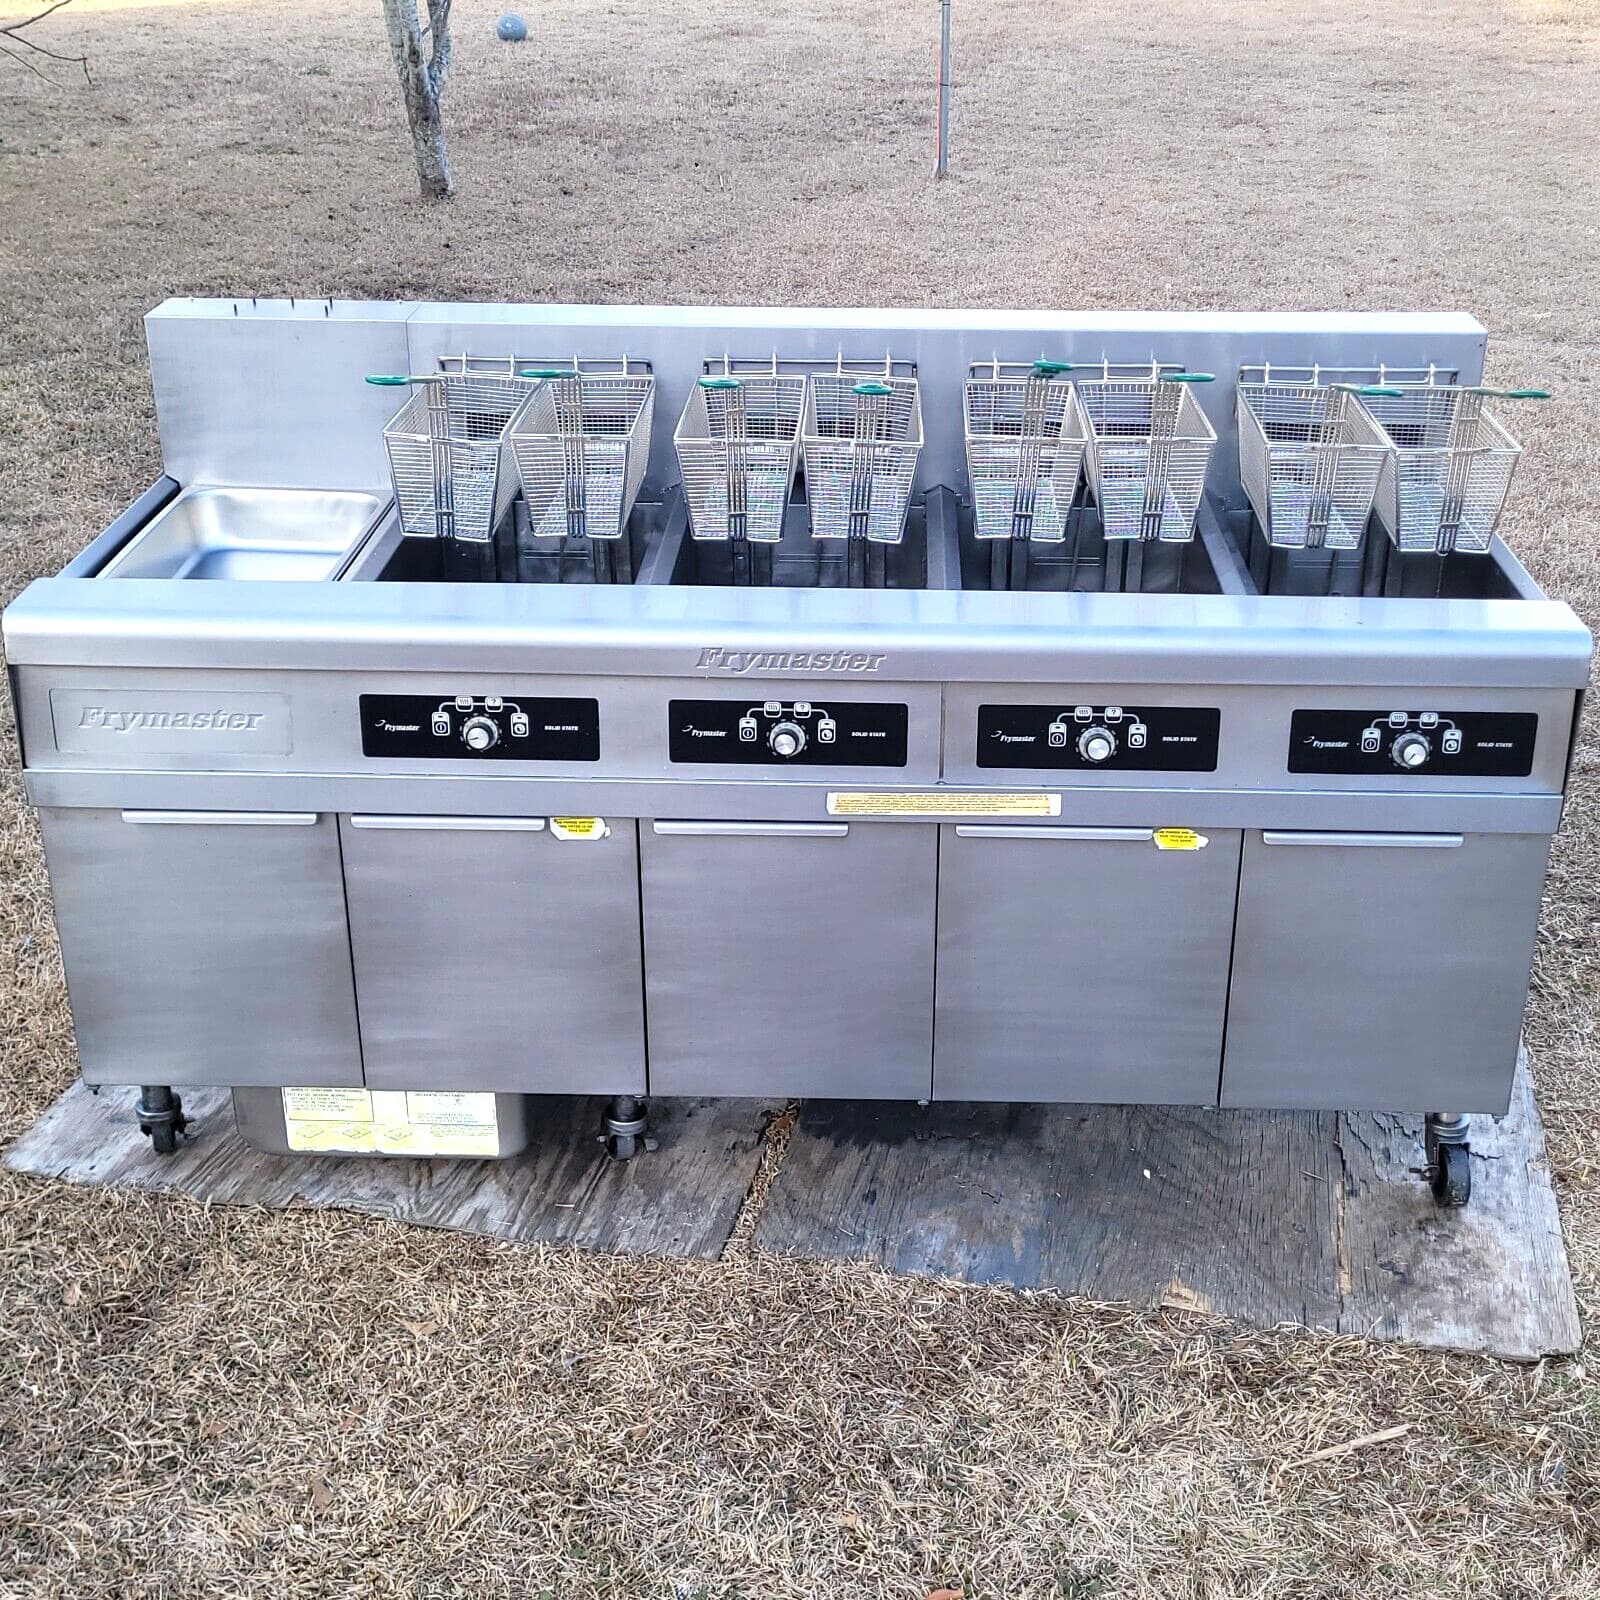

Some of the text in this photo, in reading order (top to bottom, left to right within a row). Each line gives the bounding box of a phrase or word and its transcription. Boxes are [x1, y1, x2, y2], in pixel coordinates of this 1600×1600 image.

[695, 647, 886, 674] Frymaster
[78, 706, 264, 732] Frymaster
[384, 723, 421, 733] Frymaster
[691, 729, 728, 738] Frymaster
[1000, 734, 1036, 743] Frymaster
[1312, 740, 1349, 749] Frymaster
